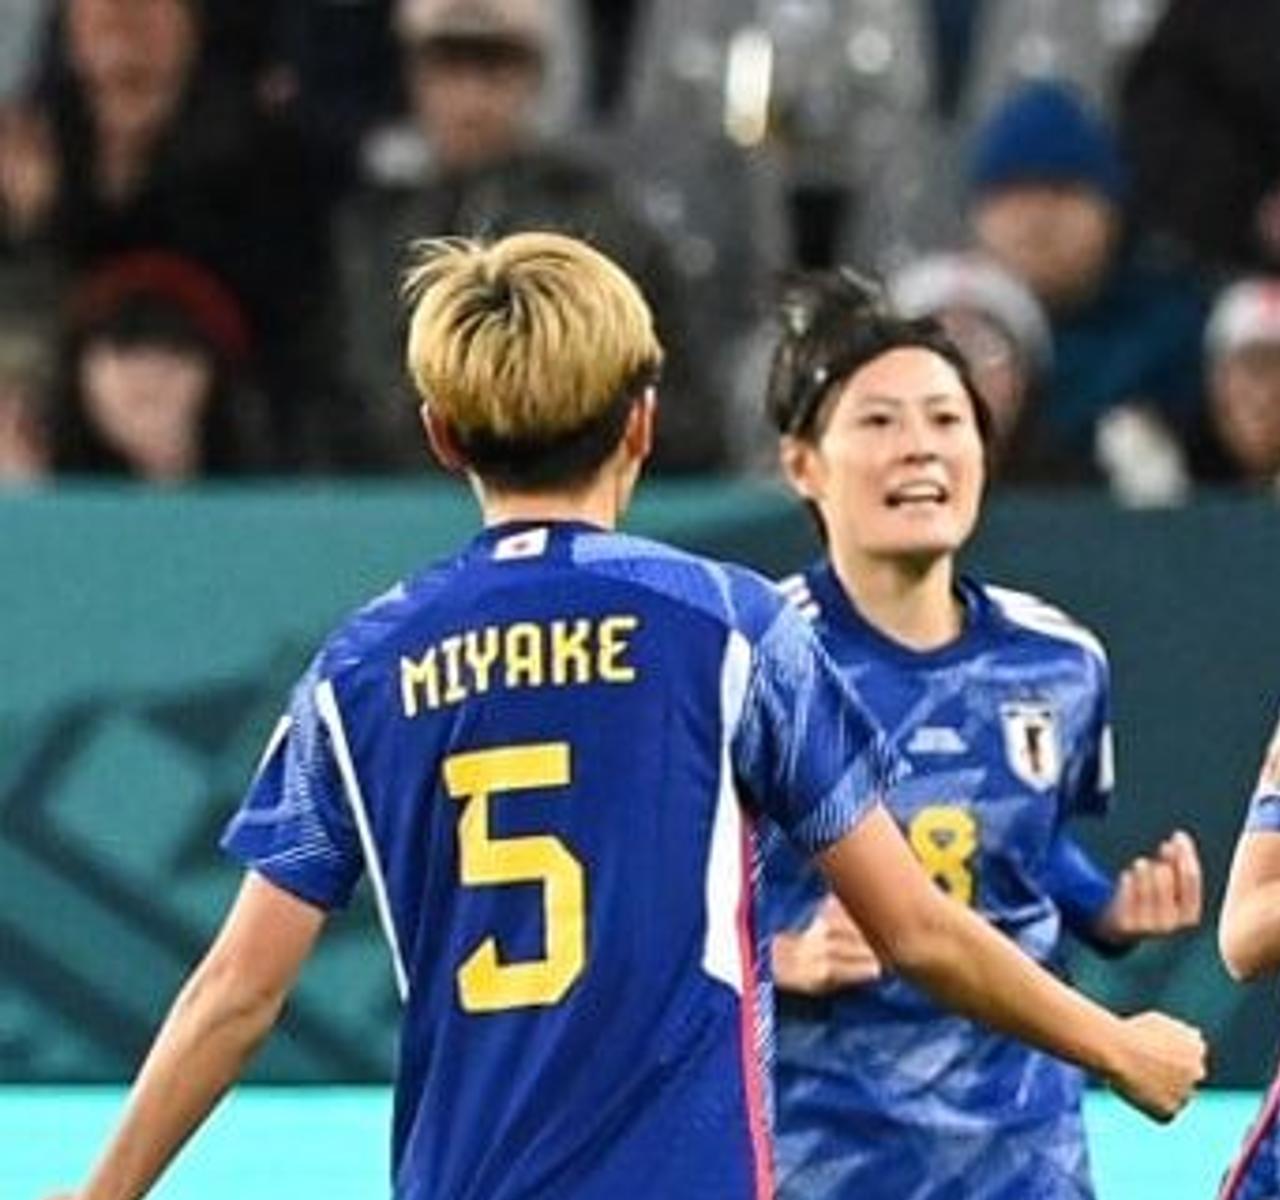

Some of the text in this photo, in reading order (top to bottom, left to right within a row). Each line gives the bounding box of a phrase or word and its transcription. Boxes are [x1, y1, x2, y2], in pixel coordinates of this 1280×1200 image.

[400, 616, 638, 719] MIYAKE
[444, 742, 586, 1012] 5
[909, 805, 976, 905] 8
